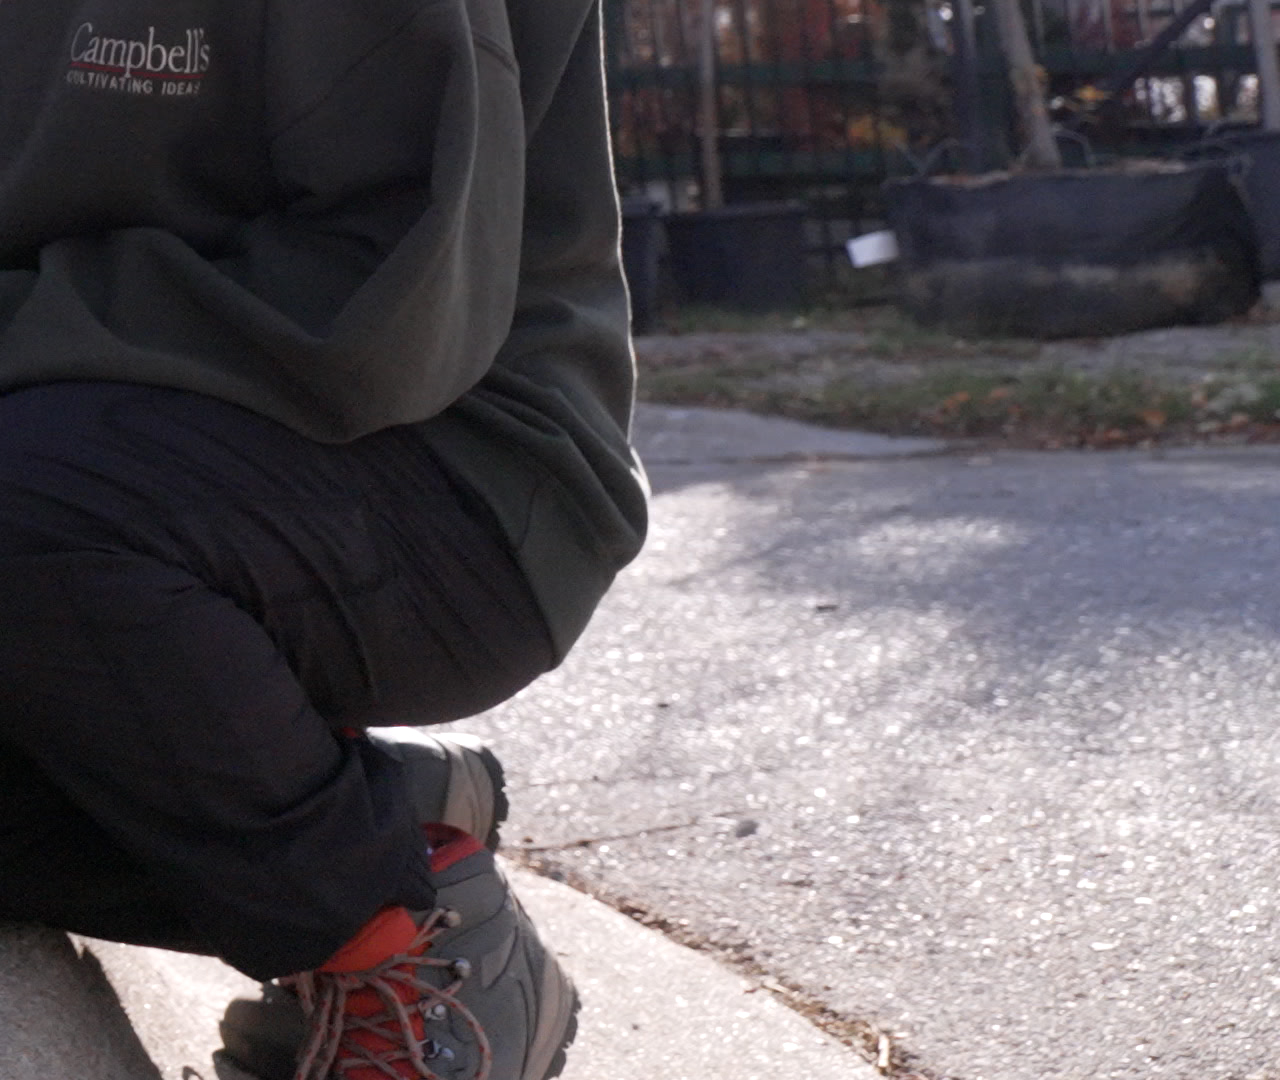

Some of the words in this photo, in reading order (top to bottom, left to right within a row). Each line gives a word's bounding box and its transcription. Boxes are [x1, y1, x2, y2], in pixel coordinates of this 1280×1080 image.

[70, 22, 210, 78] Campbell's
[66, 70, 153, 95] CULTIVATING
[161, 81, 201, 96] IDEAS
